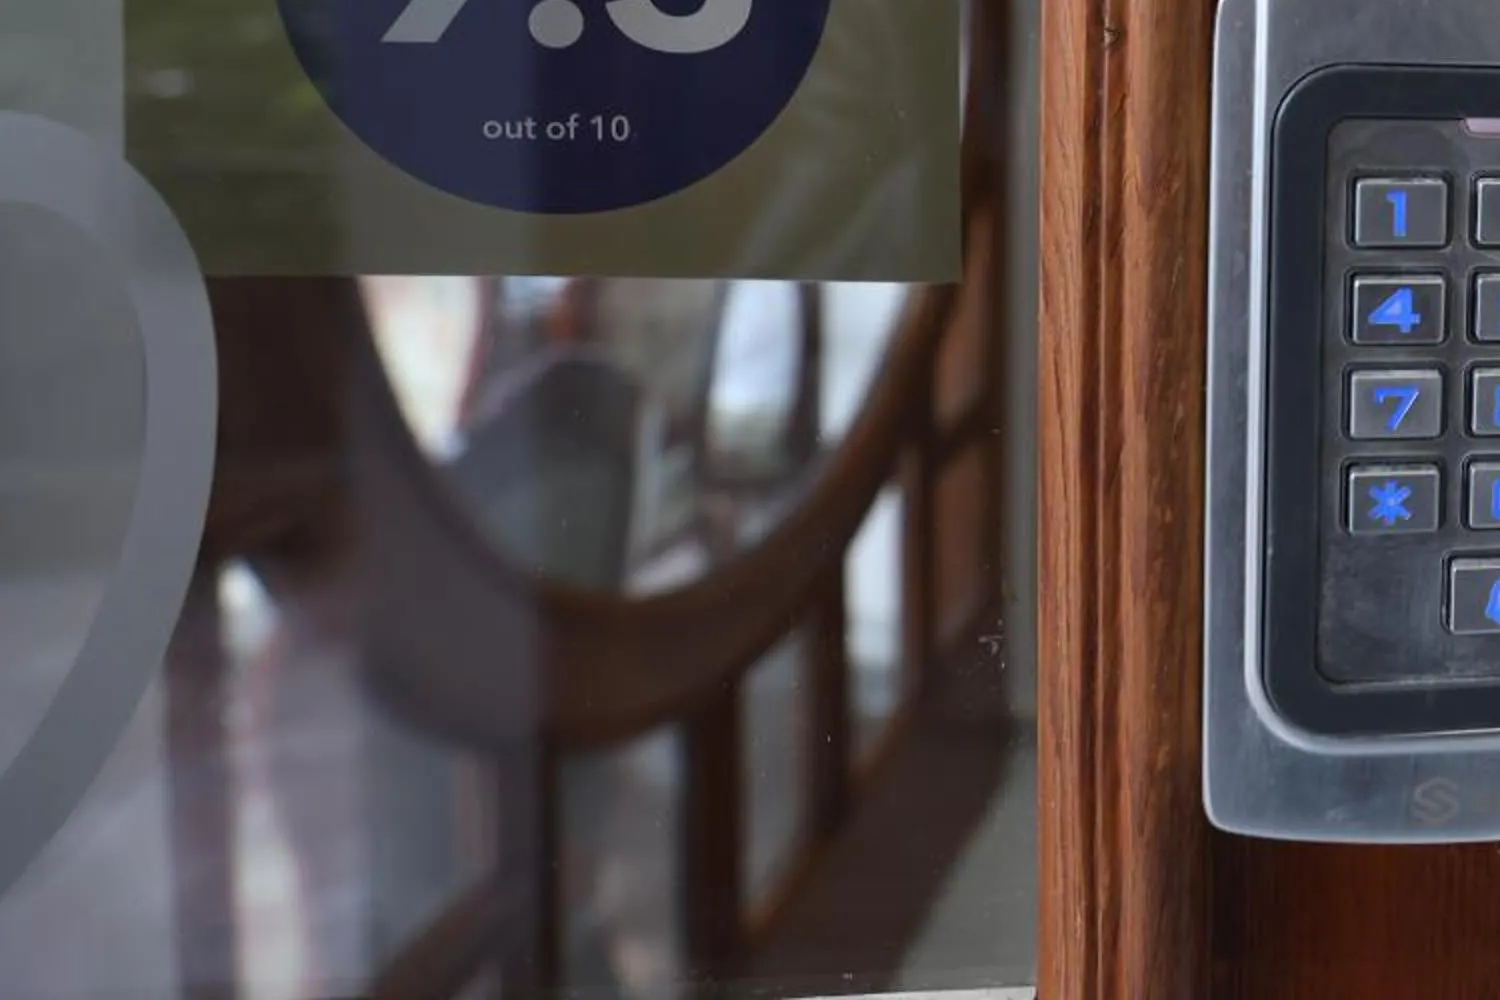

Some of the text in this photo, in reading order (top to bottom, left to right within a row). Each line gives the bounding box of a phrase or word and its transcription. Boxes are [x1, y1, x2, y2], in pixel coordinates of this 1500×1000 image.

[482, 112, 631, 141] out of 10
[1385, 190, 1407, 237] 1
[1367, 287, 1421, 334] 4
[1372, 385, 1420, 432] 7
